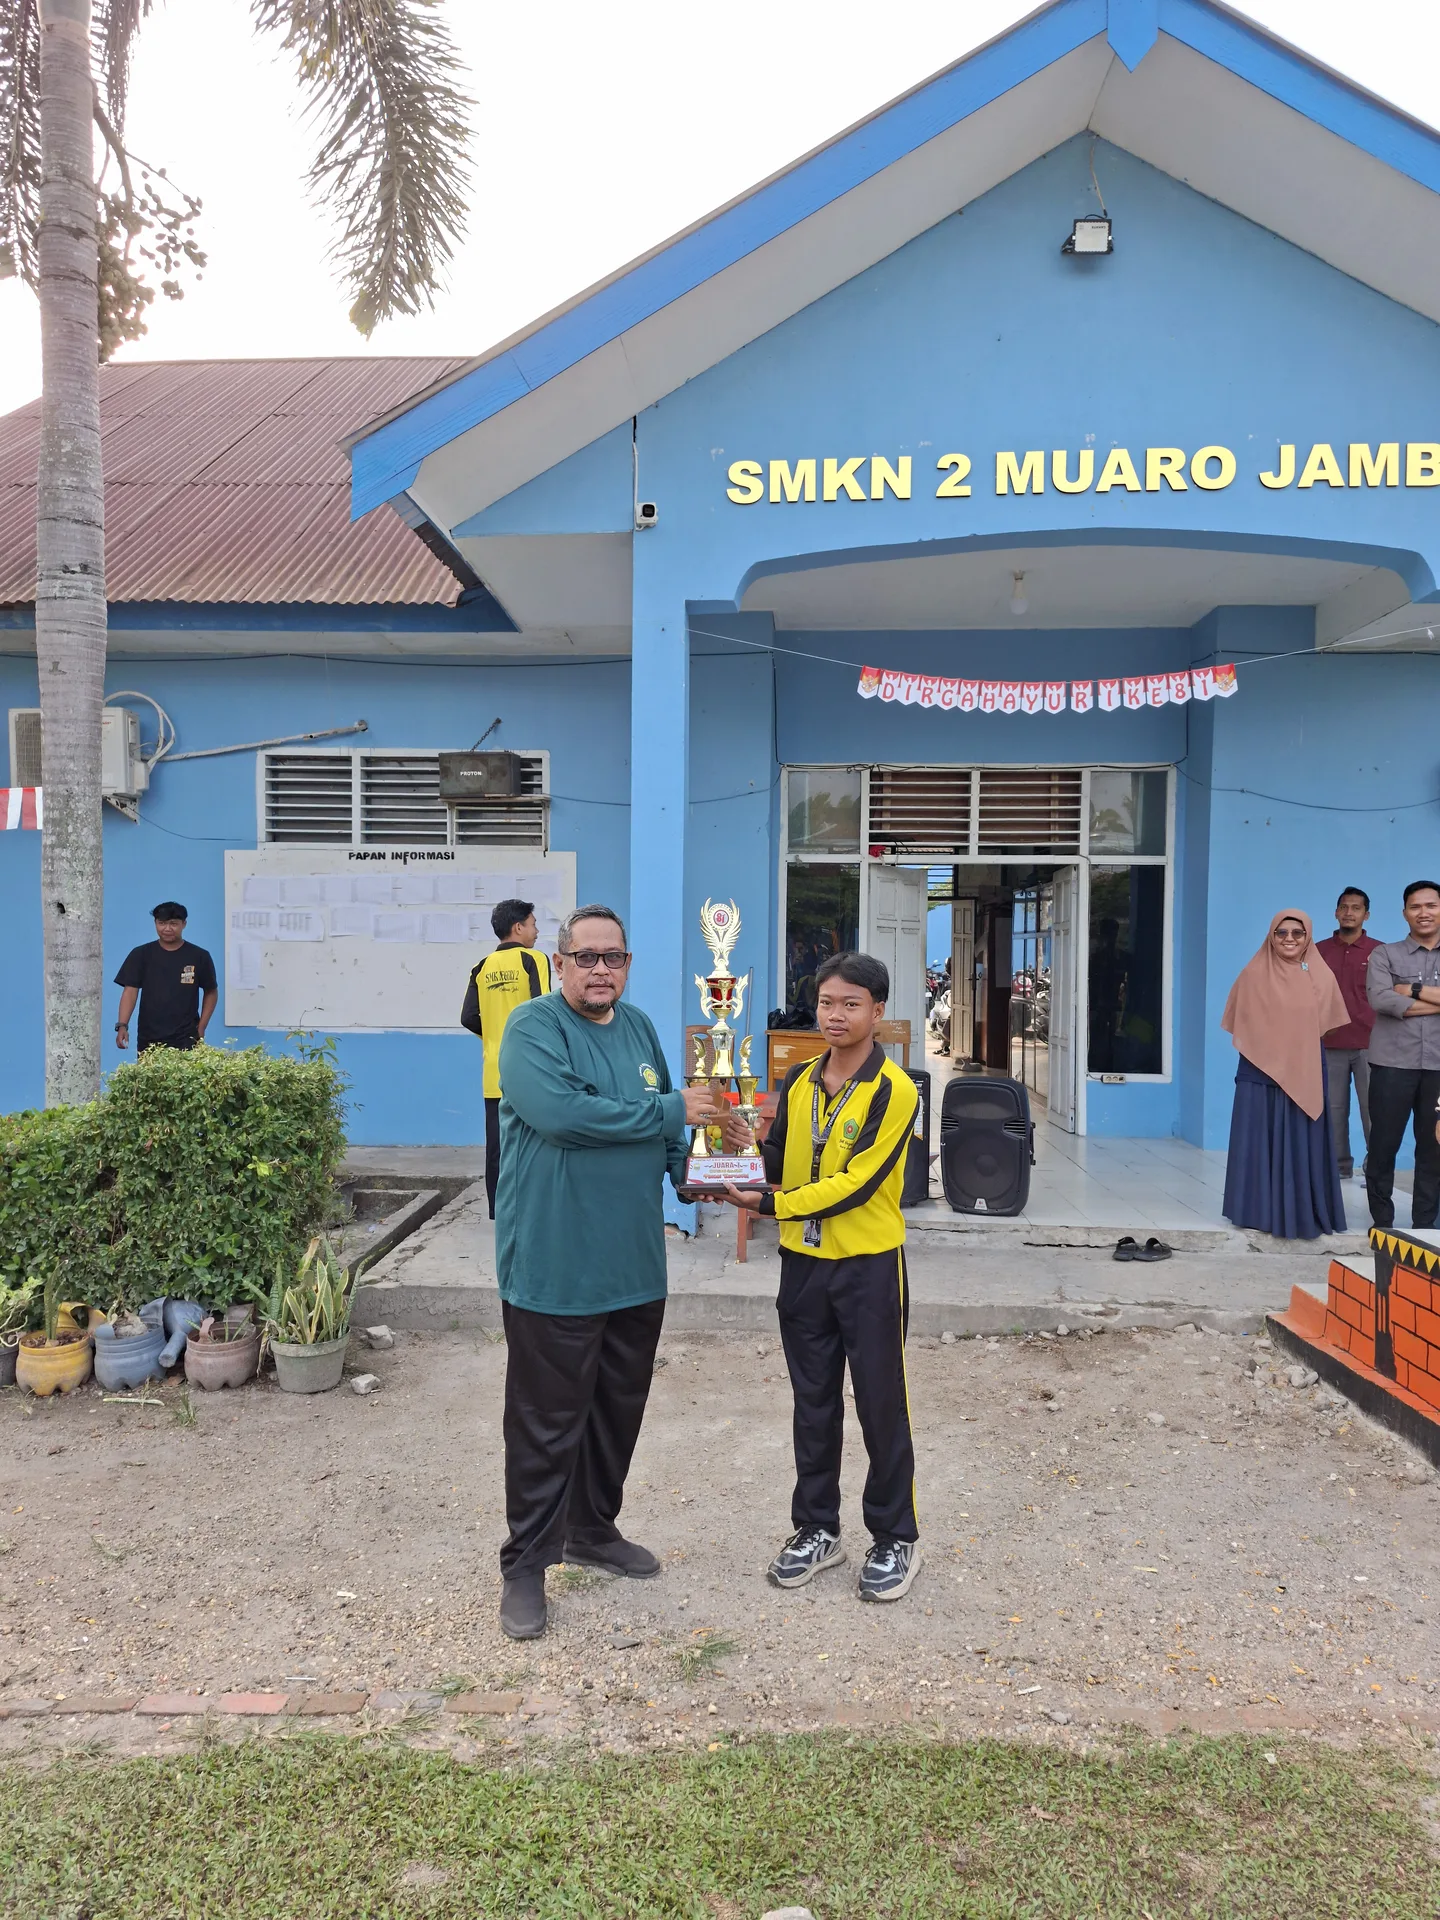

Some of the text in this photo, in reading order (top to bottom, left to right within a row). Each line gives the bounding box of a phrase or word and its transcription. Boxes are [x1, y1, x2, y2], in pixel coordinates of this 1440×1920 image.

[726, 442, 1440, 505] SMKN 2 MUARO JAMB
[348, 851, 455, 865] PAPAN INFORMASI
[515, 970, 520, 981] 2
[750, 1162, 758, 1171] 81
